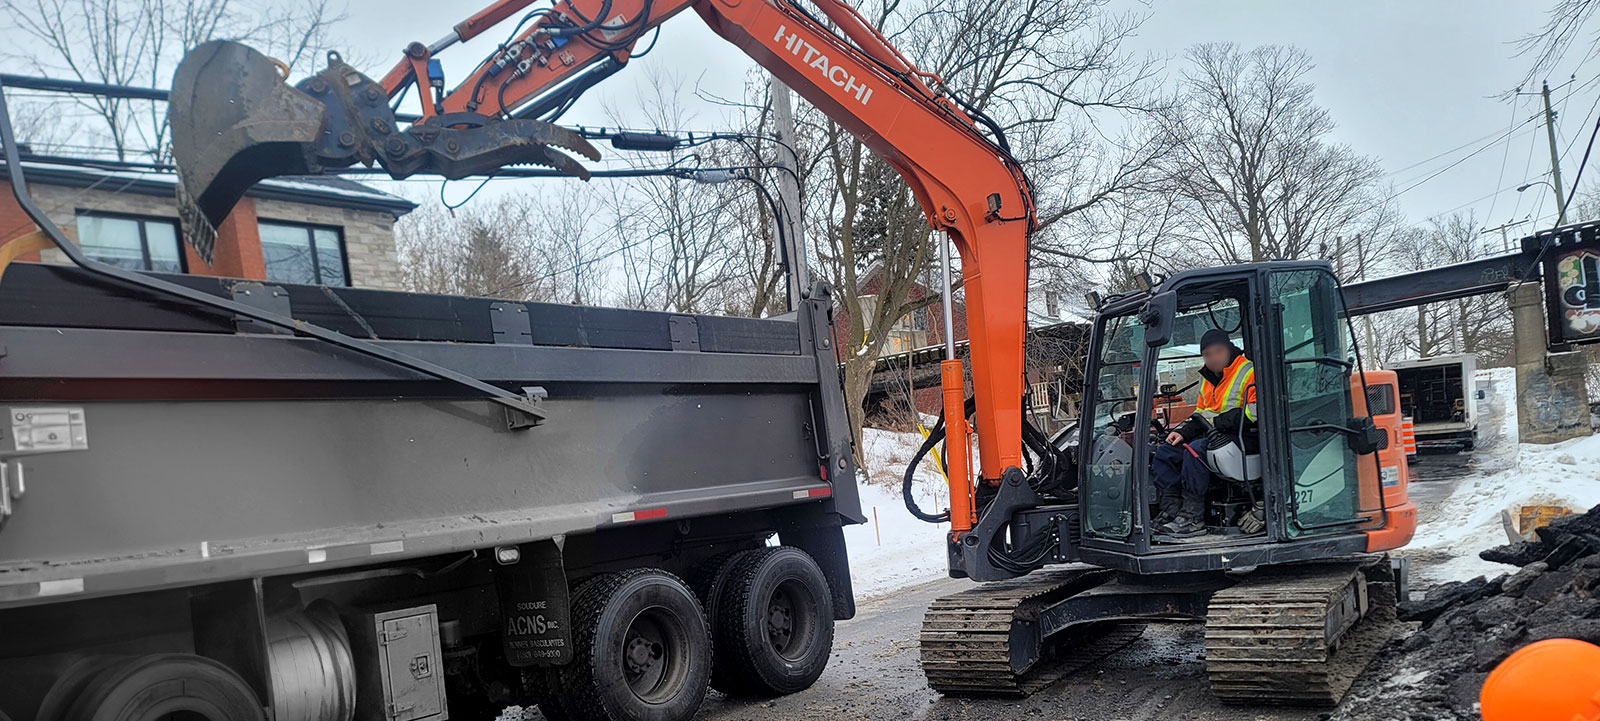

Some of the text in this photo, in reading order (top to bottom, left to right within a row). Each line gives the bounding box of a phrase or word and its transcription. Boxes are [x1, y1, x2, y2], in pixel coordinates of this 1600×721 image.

[773, 24, 873, 106] HITACHI
[517, 601, 546, 610] SOUDURE
[508, 615, 546, 635] ACNS
